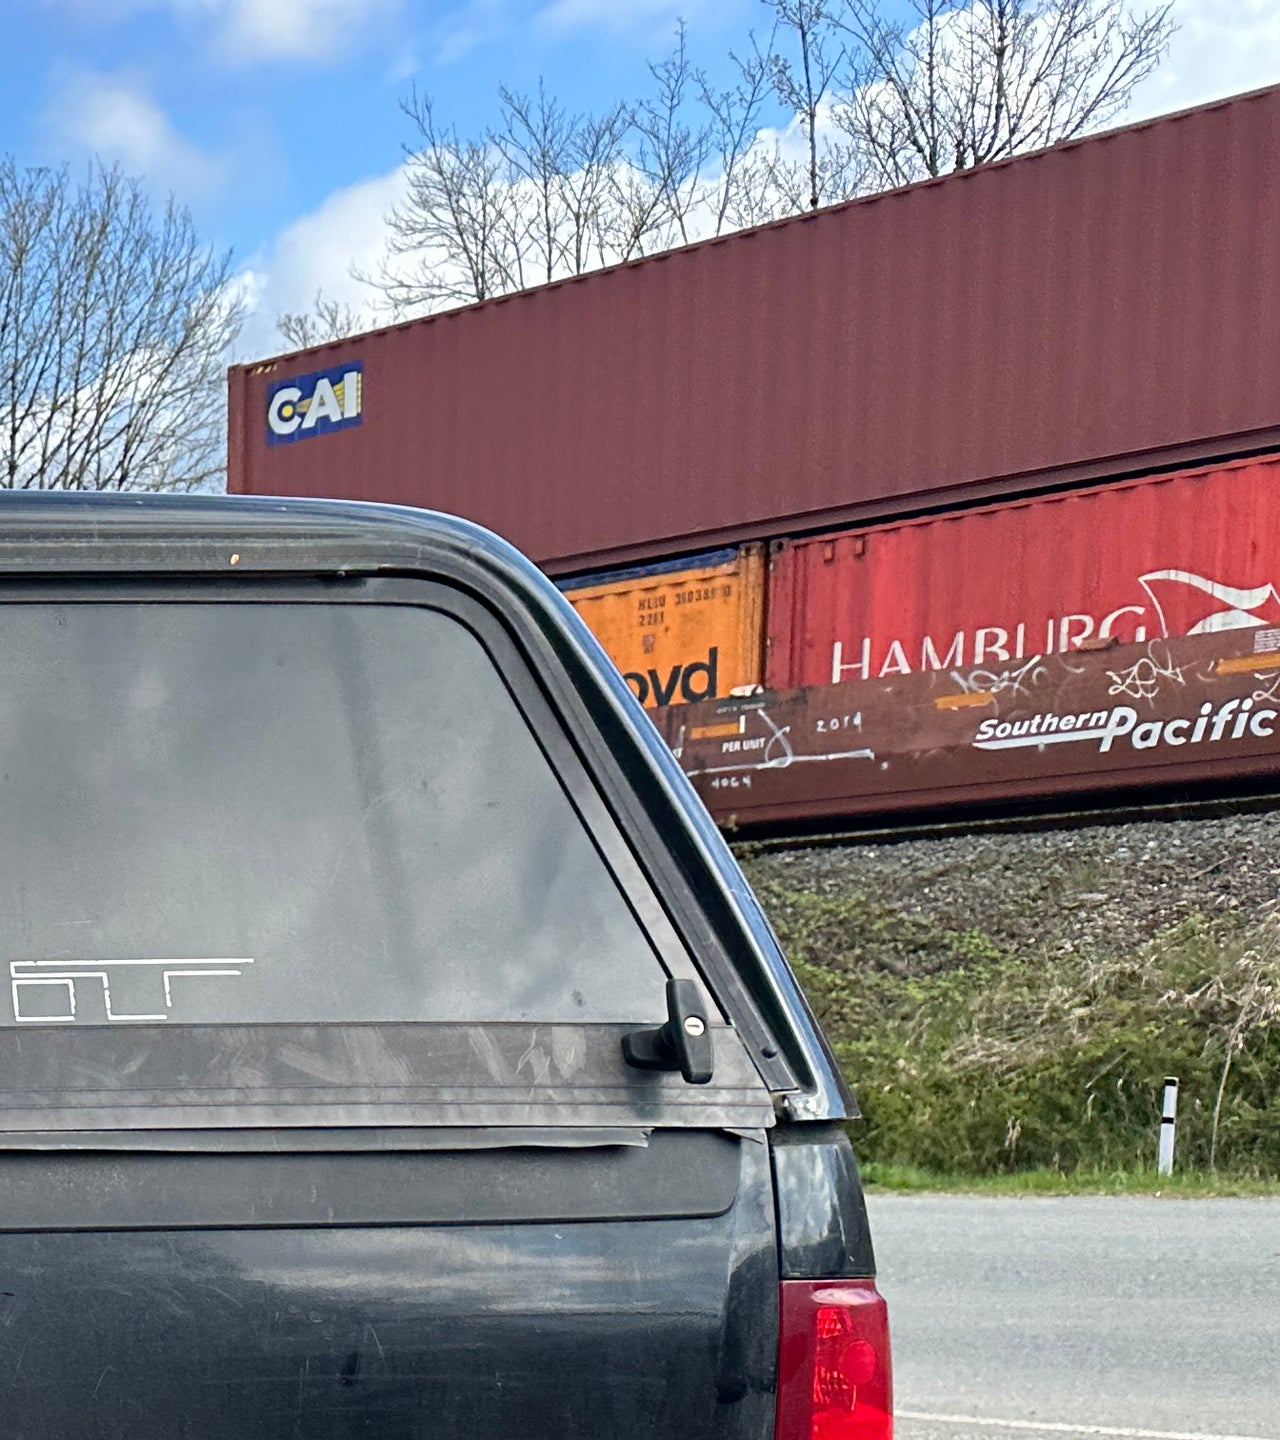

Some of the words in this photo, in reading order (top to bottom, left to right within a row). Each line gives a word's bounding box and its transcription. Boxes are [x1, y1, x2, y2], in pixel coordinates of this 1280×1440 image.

[268, 371, 360, 435] CAI
[832, 606, 1146, 683] HAMBURG
[975, 709, 1108, 741] Southern
[1098, 697, 1278, 754] Pacific
